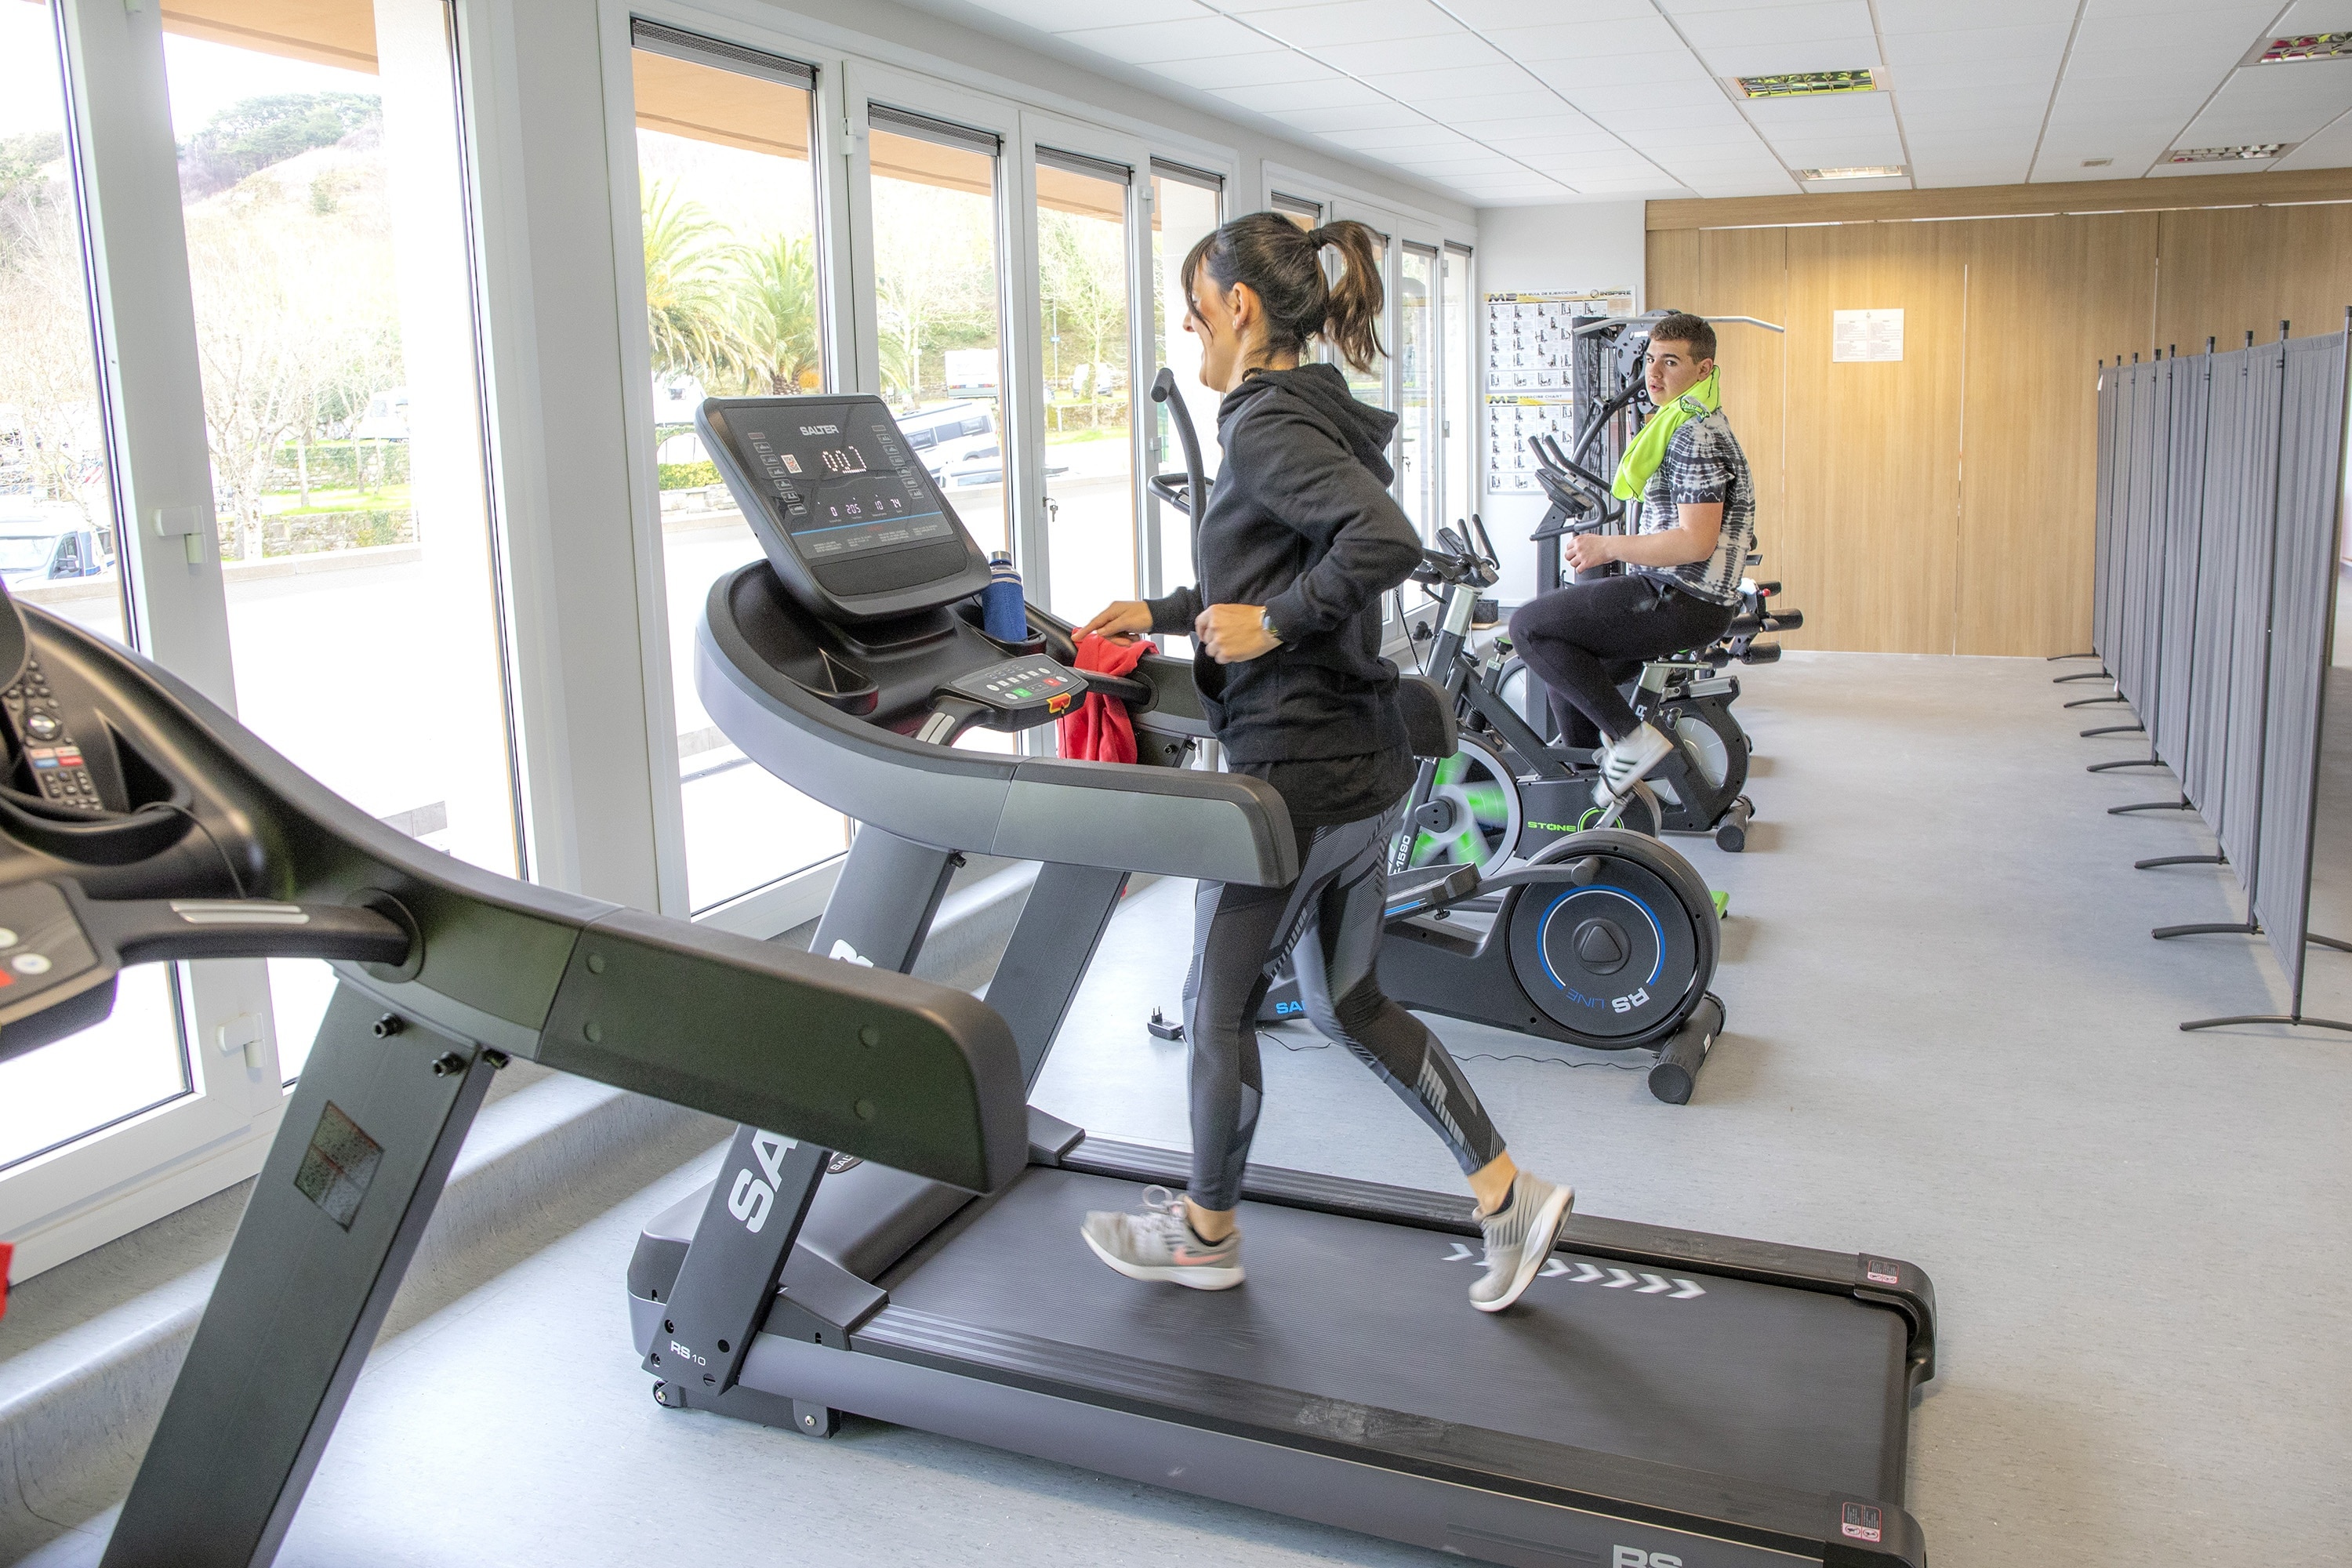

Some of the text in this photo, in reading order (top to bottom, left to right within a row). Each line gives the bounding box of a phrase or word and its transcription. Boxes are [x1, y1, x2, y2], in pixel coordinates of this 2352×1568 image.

[1489, 293, 1518, 302] M2
[800, 425, 839, 435] SALTER
[1528, 821, 1577, 832] STONE
[1566, 987, 1650, 1013] RS LINE
[830, 1155, 855, 1171] SAL
[728, 1128, 799, 1233] SA
[670, 1340, 706, 1366] RS 10
